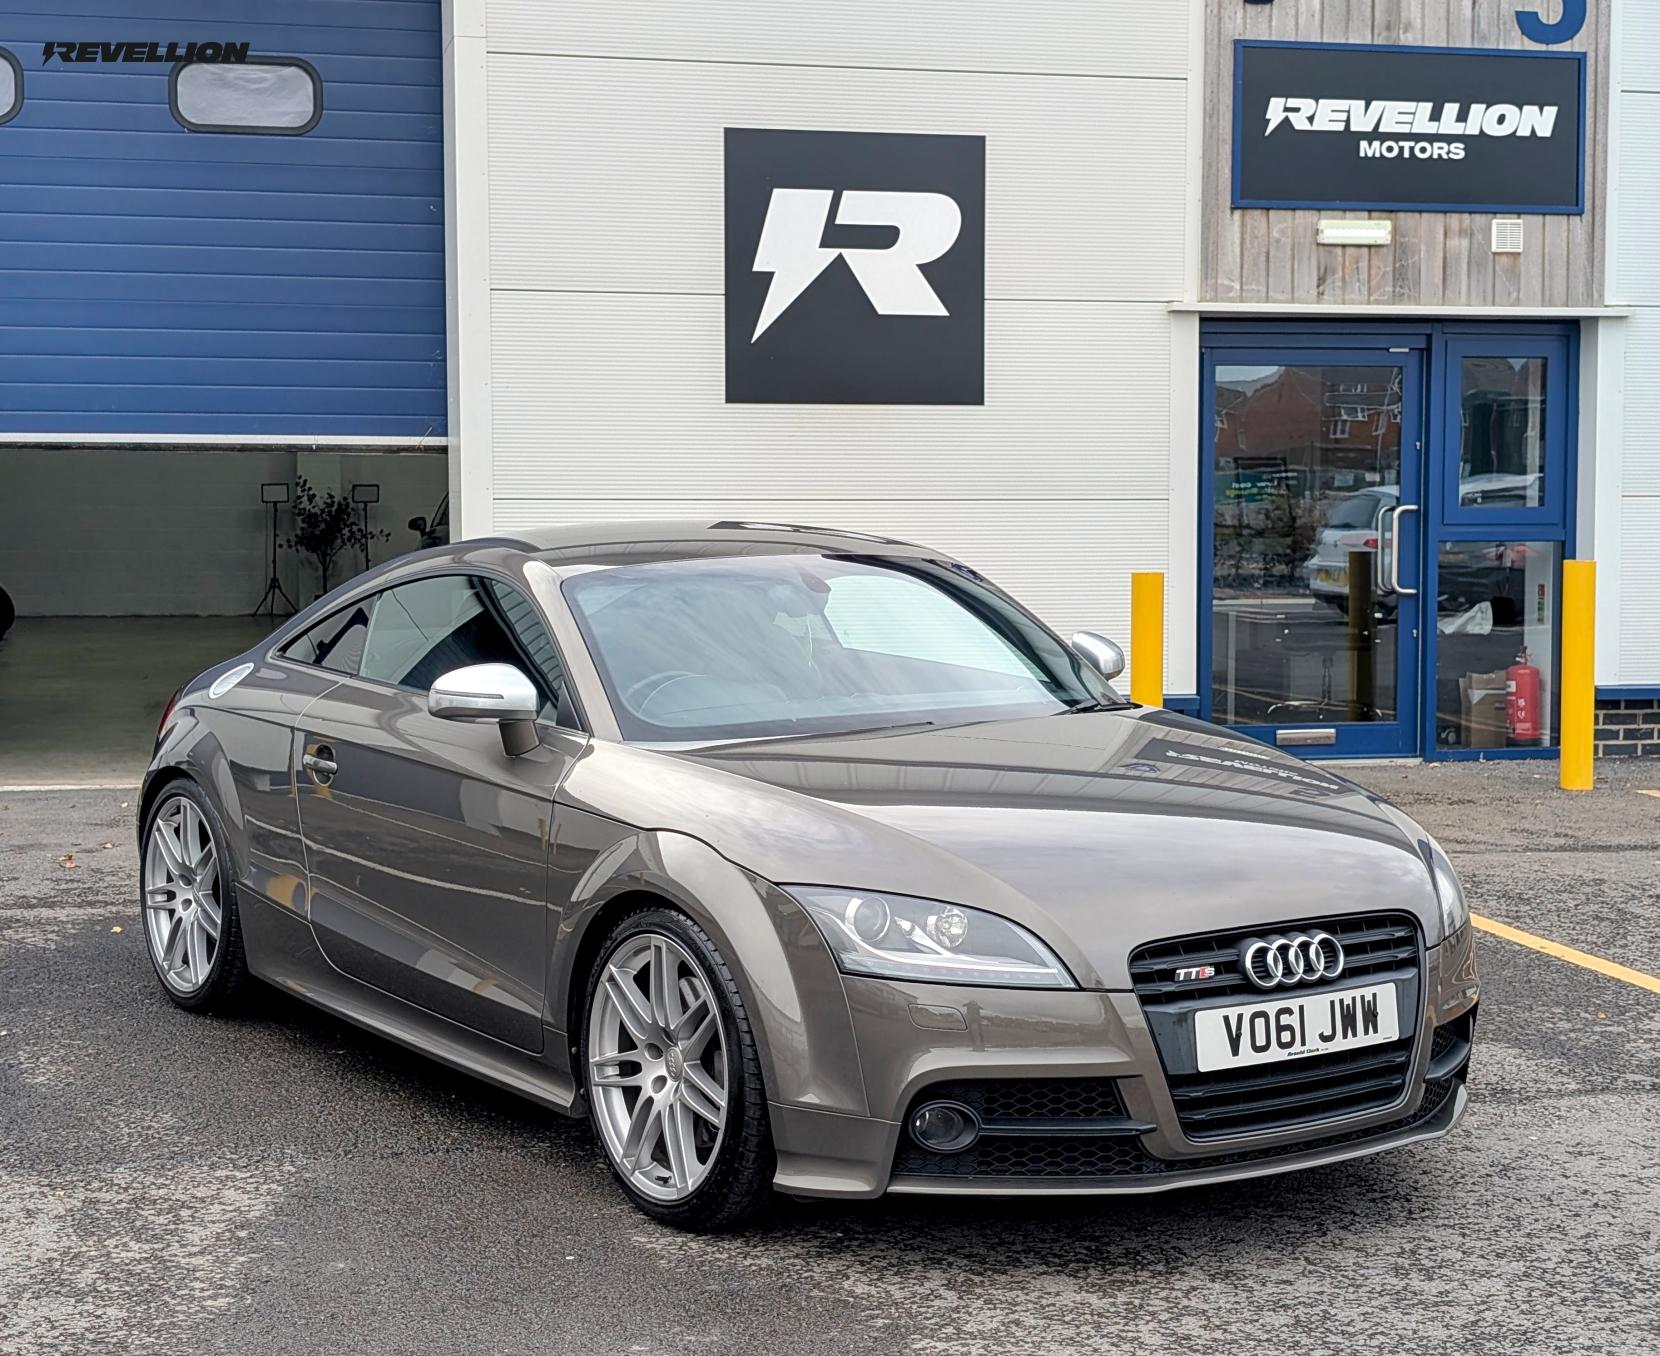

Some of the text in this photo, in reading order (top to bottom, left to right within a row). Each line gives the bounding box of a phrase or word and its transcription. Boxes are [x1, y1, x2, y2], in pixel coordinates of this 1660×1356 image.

[1264, 97, 1559, 138] REVELLION
[1359, 140, 1466, 161] MOTORS
[1174, 965, 1216, 981] TTS
[1318, 992, 1380, 1044] JWW
